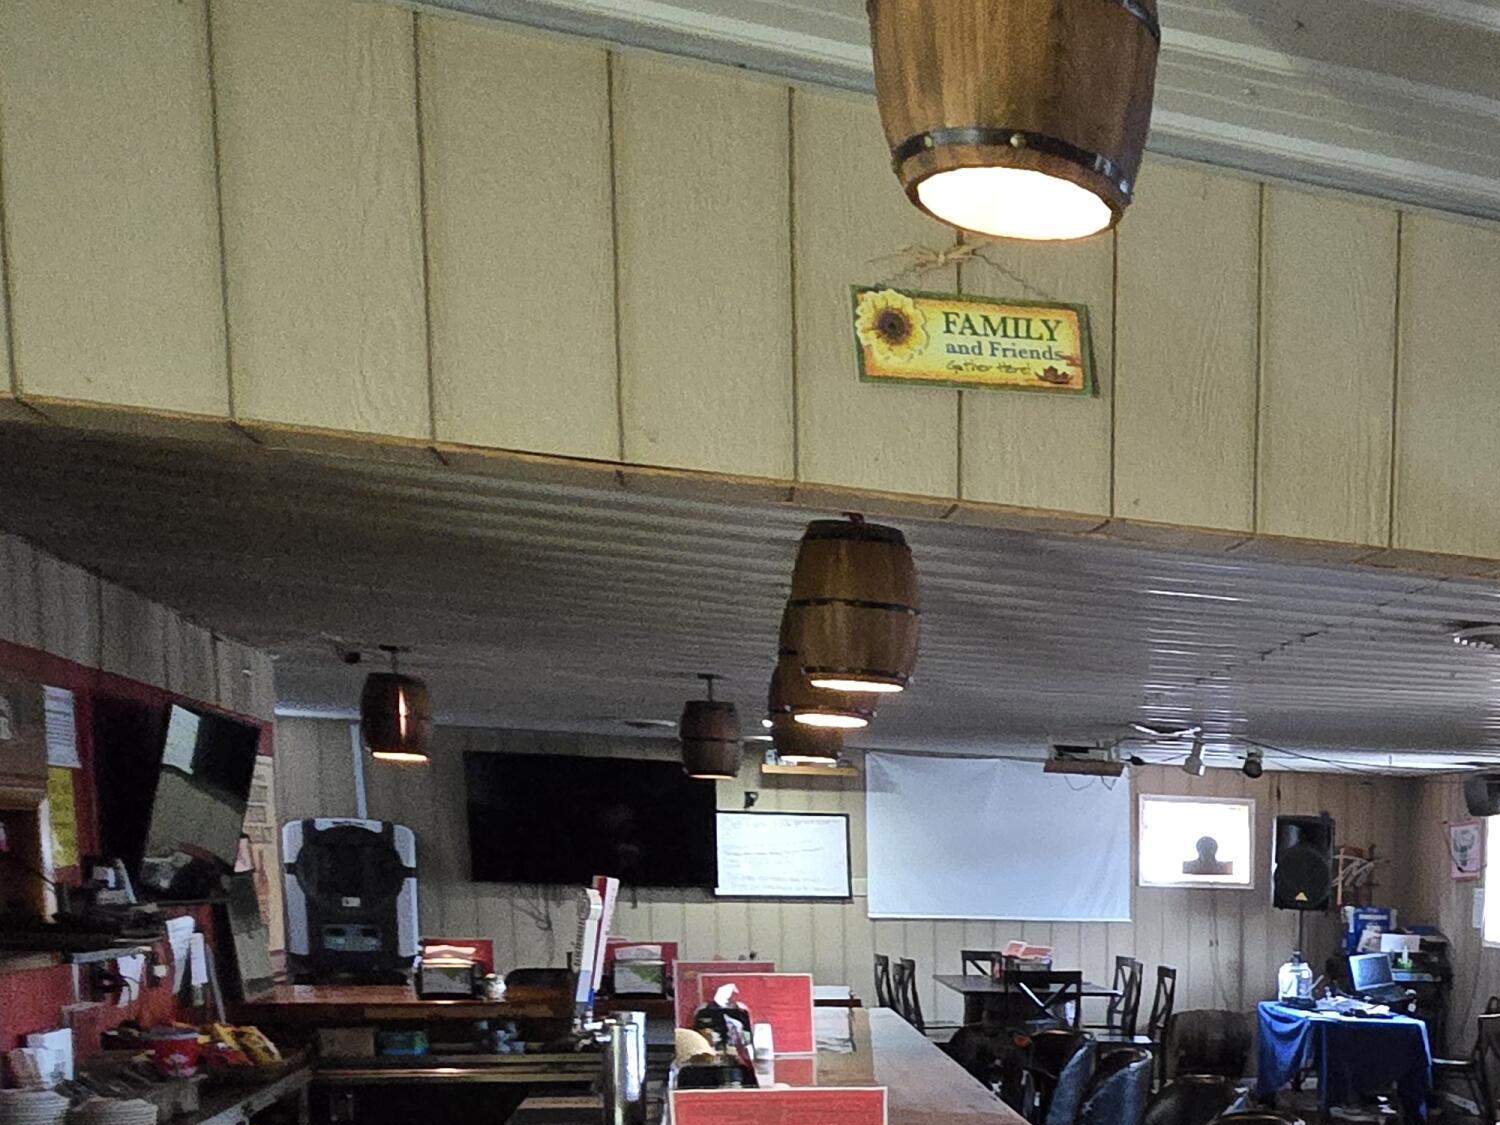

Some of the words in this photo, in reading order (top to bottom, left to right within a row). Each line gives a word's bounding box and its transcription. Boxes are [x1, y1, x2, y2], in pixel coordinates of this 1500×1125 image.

[942, 311, 1062, 342] FAMILY
[945, 341, 983, 356] and
[989, 341, 1064, 361] Friends
